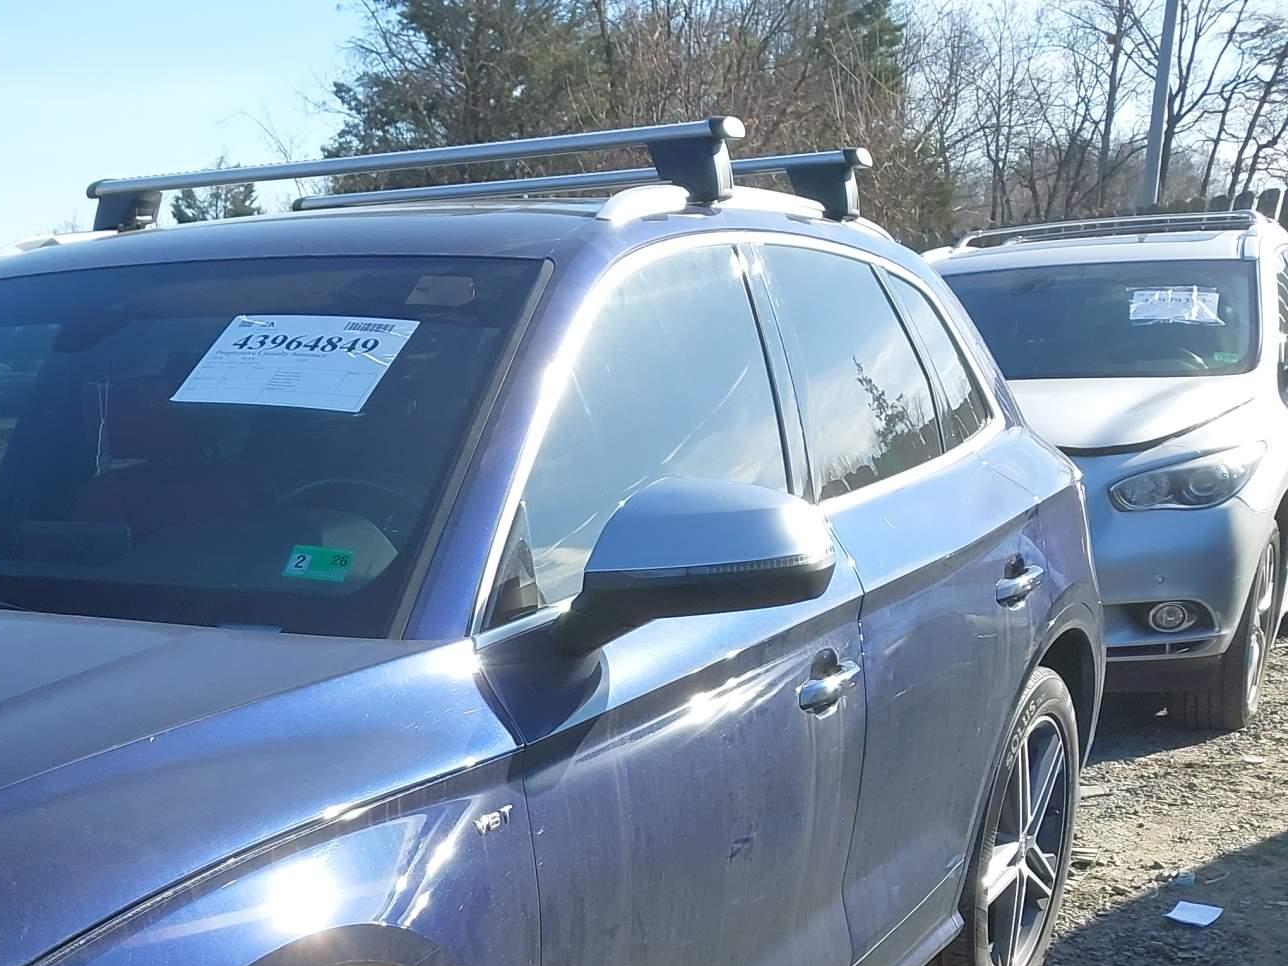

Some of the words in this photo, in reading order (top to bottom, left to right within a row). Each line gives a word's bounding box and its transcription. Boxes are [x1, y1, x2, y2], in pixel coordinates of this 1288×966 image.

[232, 333, 380, 354] 43964849
[294, 554, 306, 569] 2
[330, 554, 350, 567] 26
